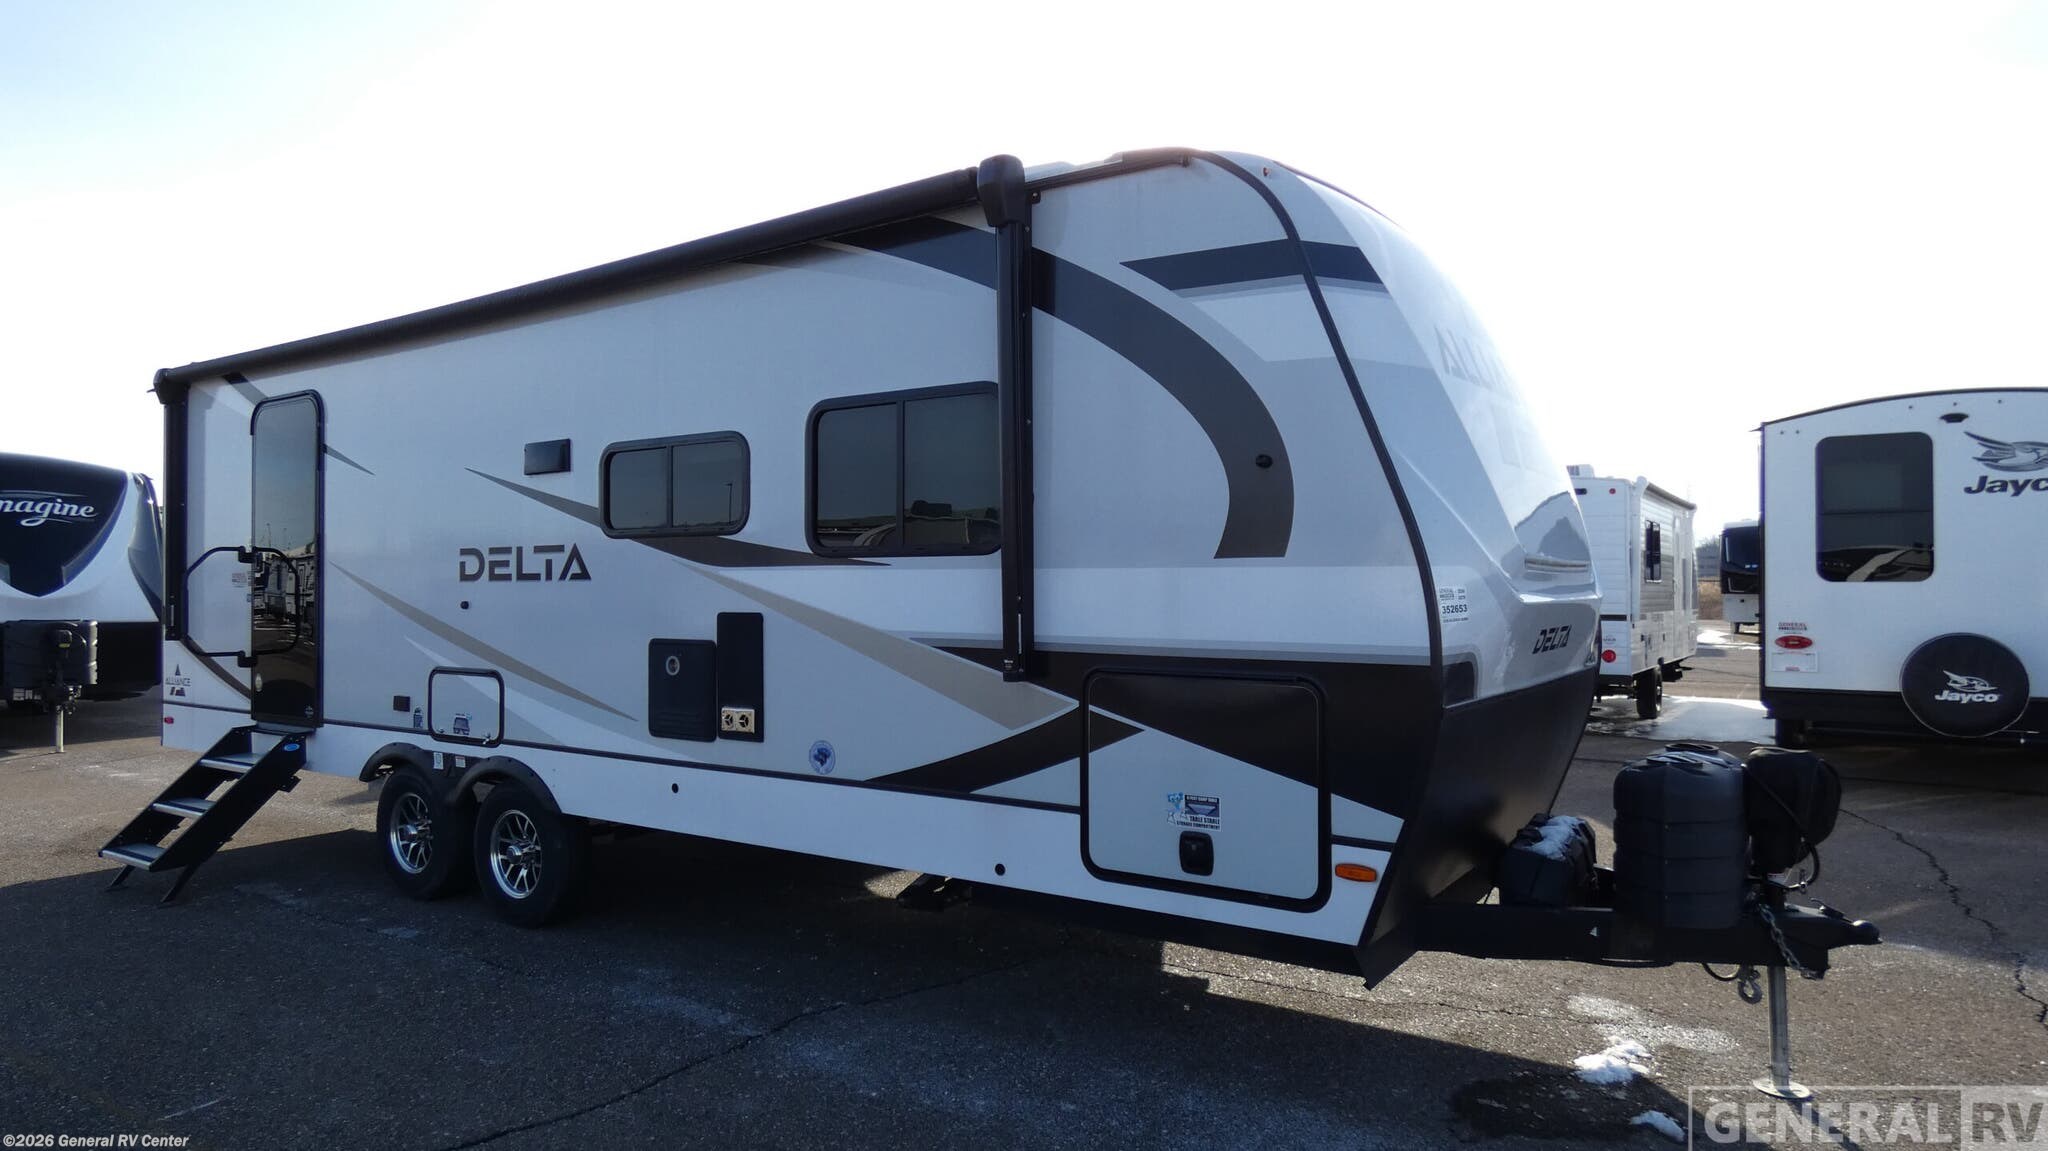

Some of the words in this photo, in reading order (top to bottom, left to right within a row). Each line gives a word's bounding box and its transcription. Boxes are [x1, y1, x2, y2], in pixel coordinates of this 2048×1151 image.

[1963, 475, 2048, 497] Jayc
[0, 498, 98, 527] magine
[459, 543, 592, 581] DELTA
[1441, 604, 1468, 614] 352653
[1532, 625, 1572, 655] DELTA
[1934, 690, 1999, 704] Jayco
